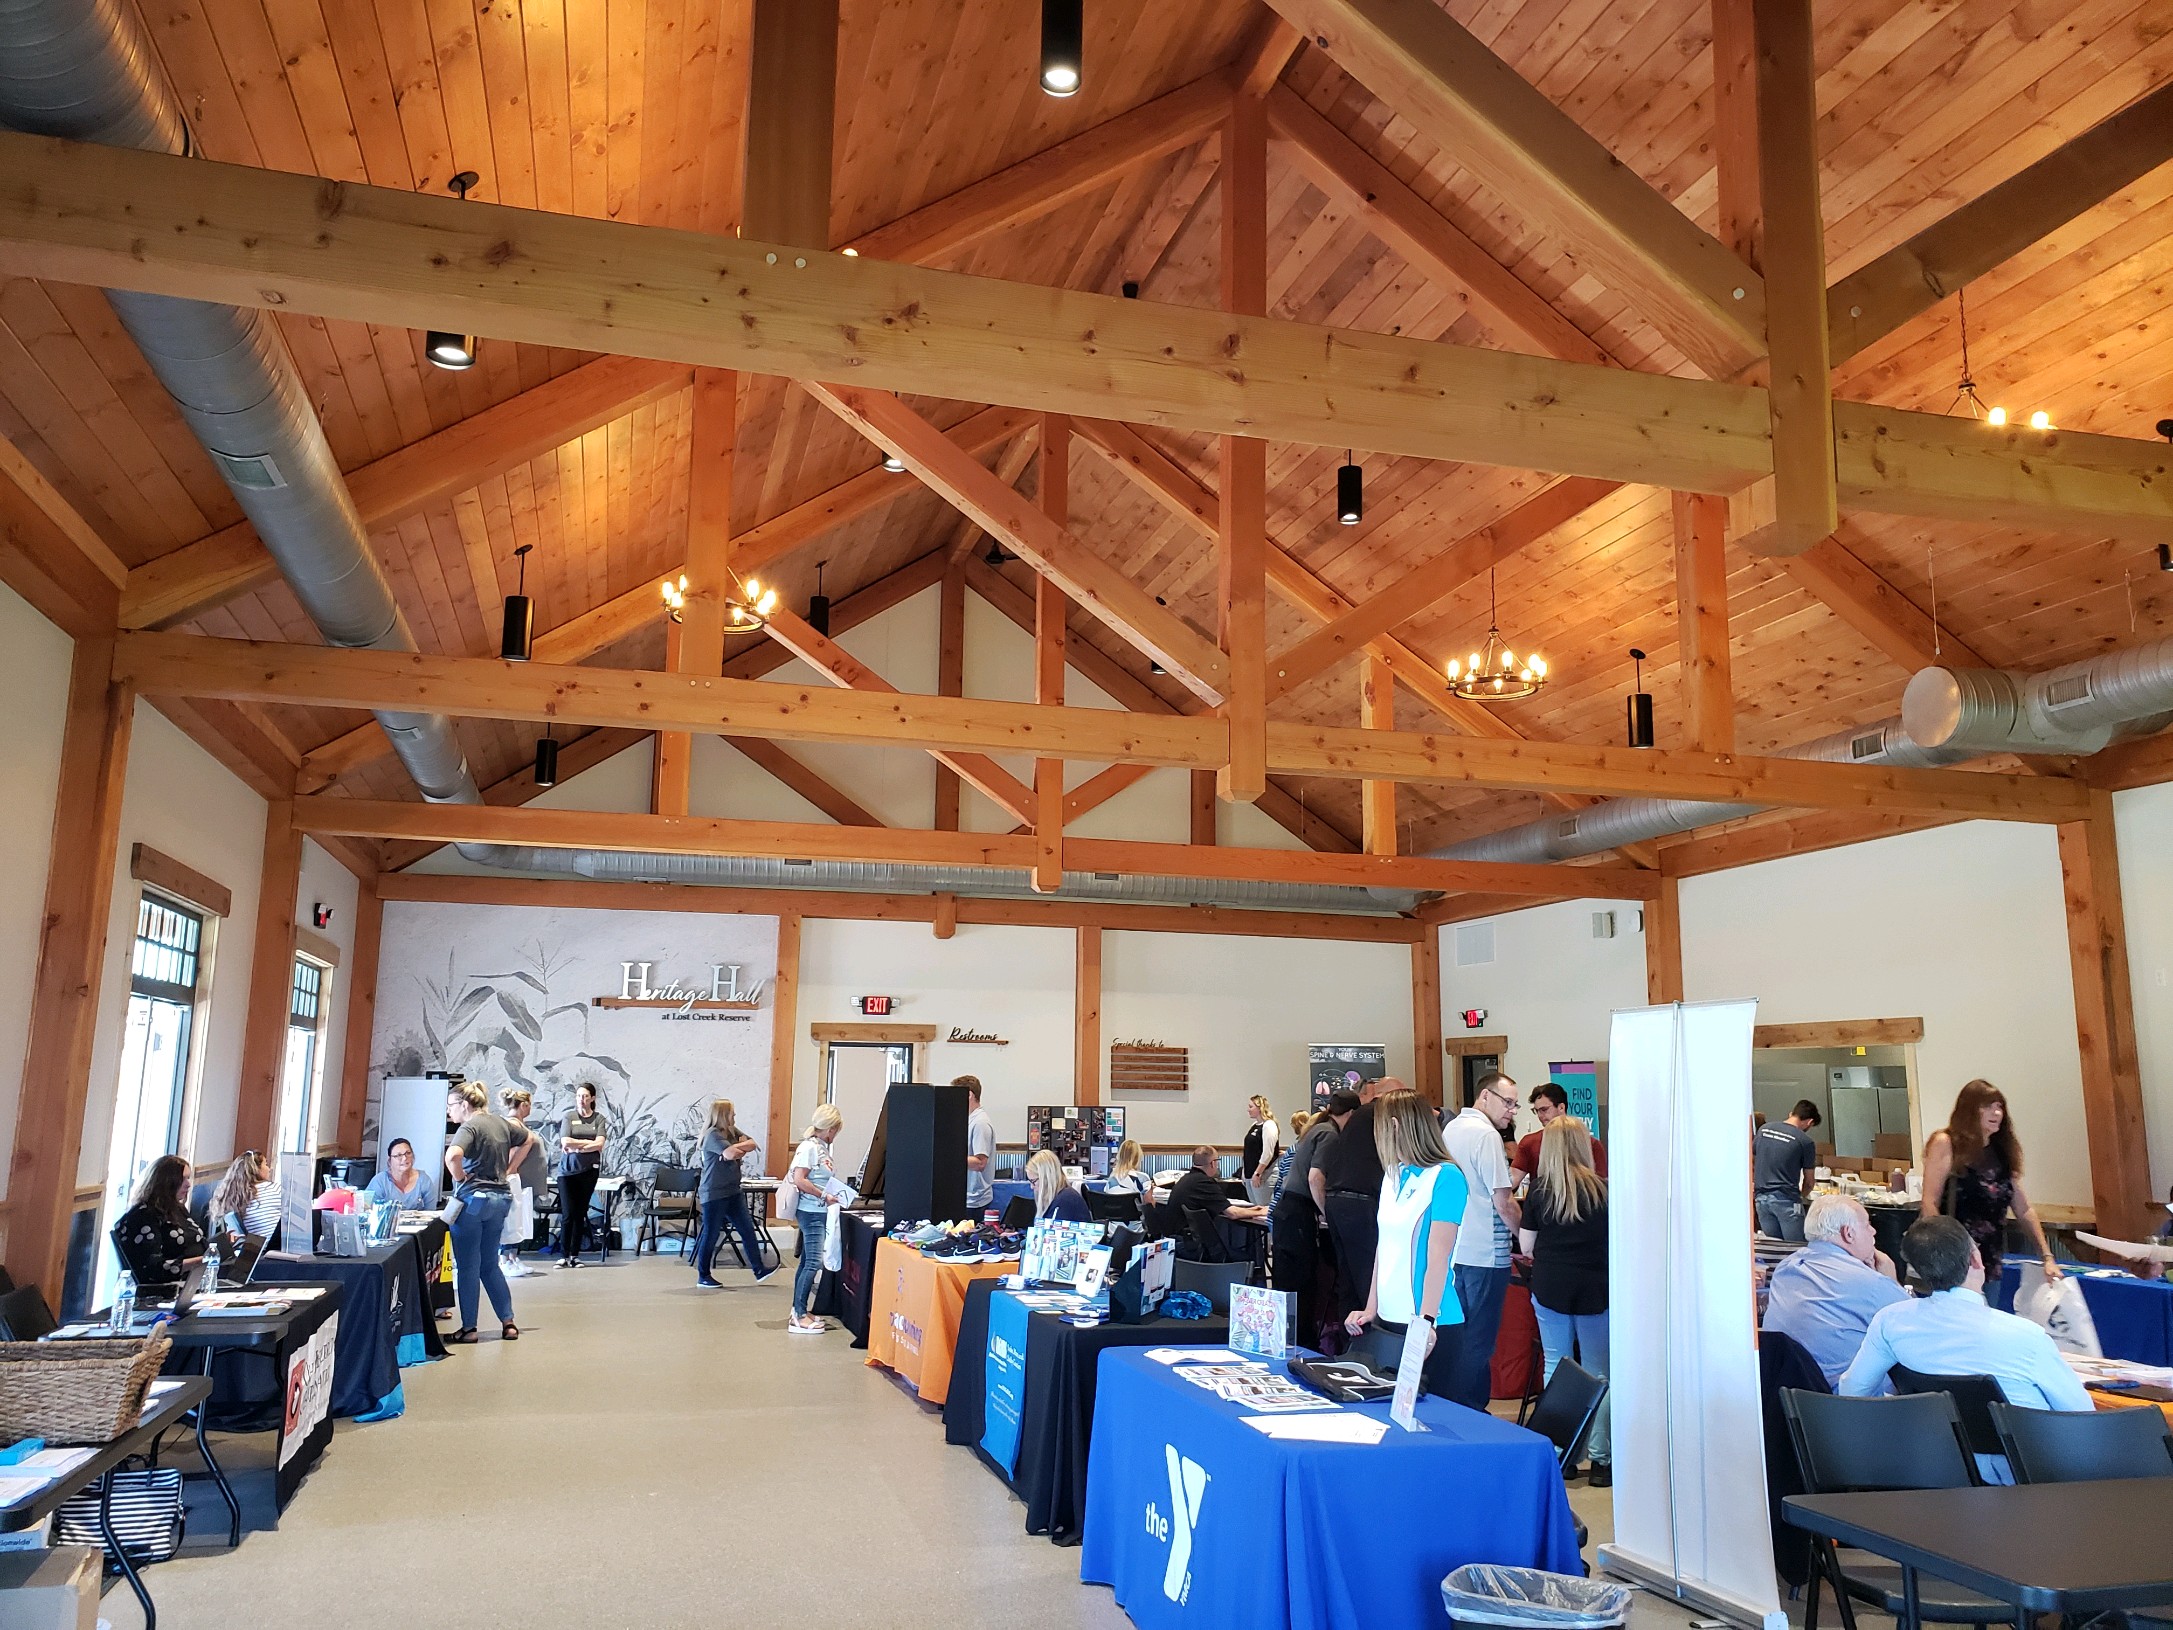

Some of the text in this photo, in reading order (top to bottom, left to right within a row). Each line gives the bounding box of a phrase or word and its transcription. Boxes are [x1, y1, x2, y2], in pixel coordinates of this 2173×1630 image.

[618, 962, 767, 1013] Heritage Hall
[867, 997, 888, 1013] EXIT
[672, 1013, 690, 1021] Lost
[692, 1013, 716, 1022] Creek
[718, 1013, 751, 1022] Reserve
[950, 1027, 998, 1041] Restrooms
[1112, 1037, 1165, 1050] Special thanks to
[1572, 1088, 1592, 1100] FIND
[1569, 1102, 1593, 1114] YOUR
[1145, 1501, 1168, 1542] the
